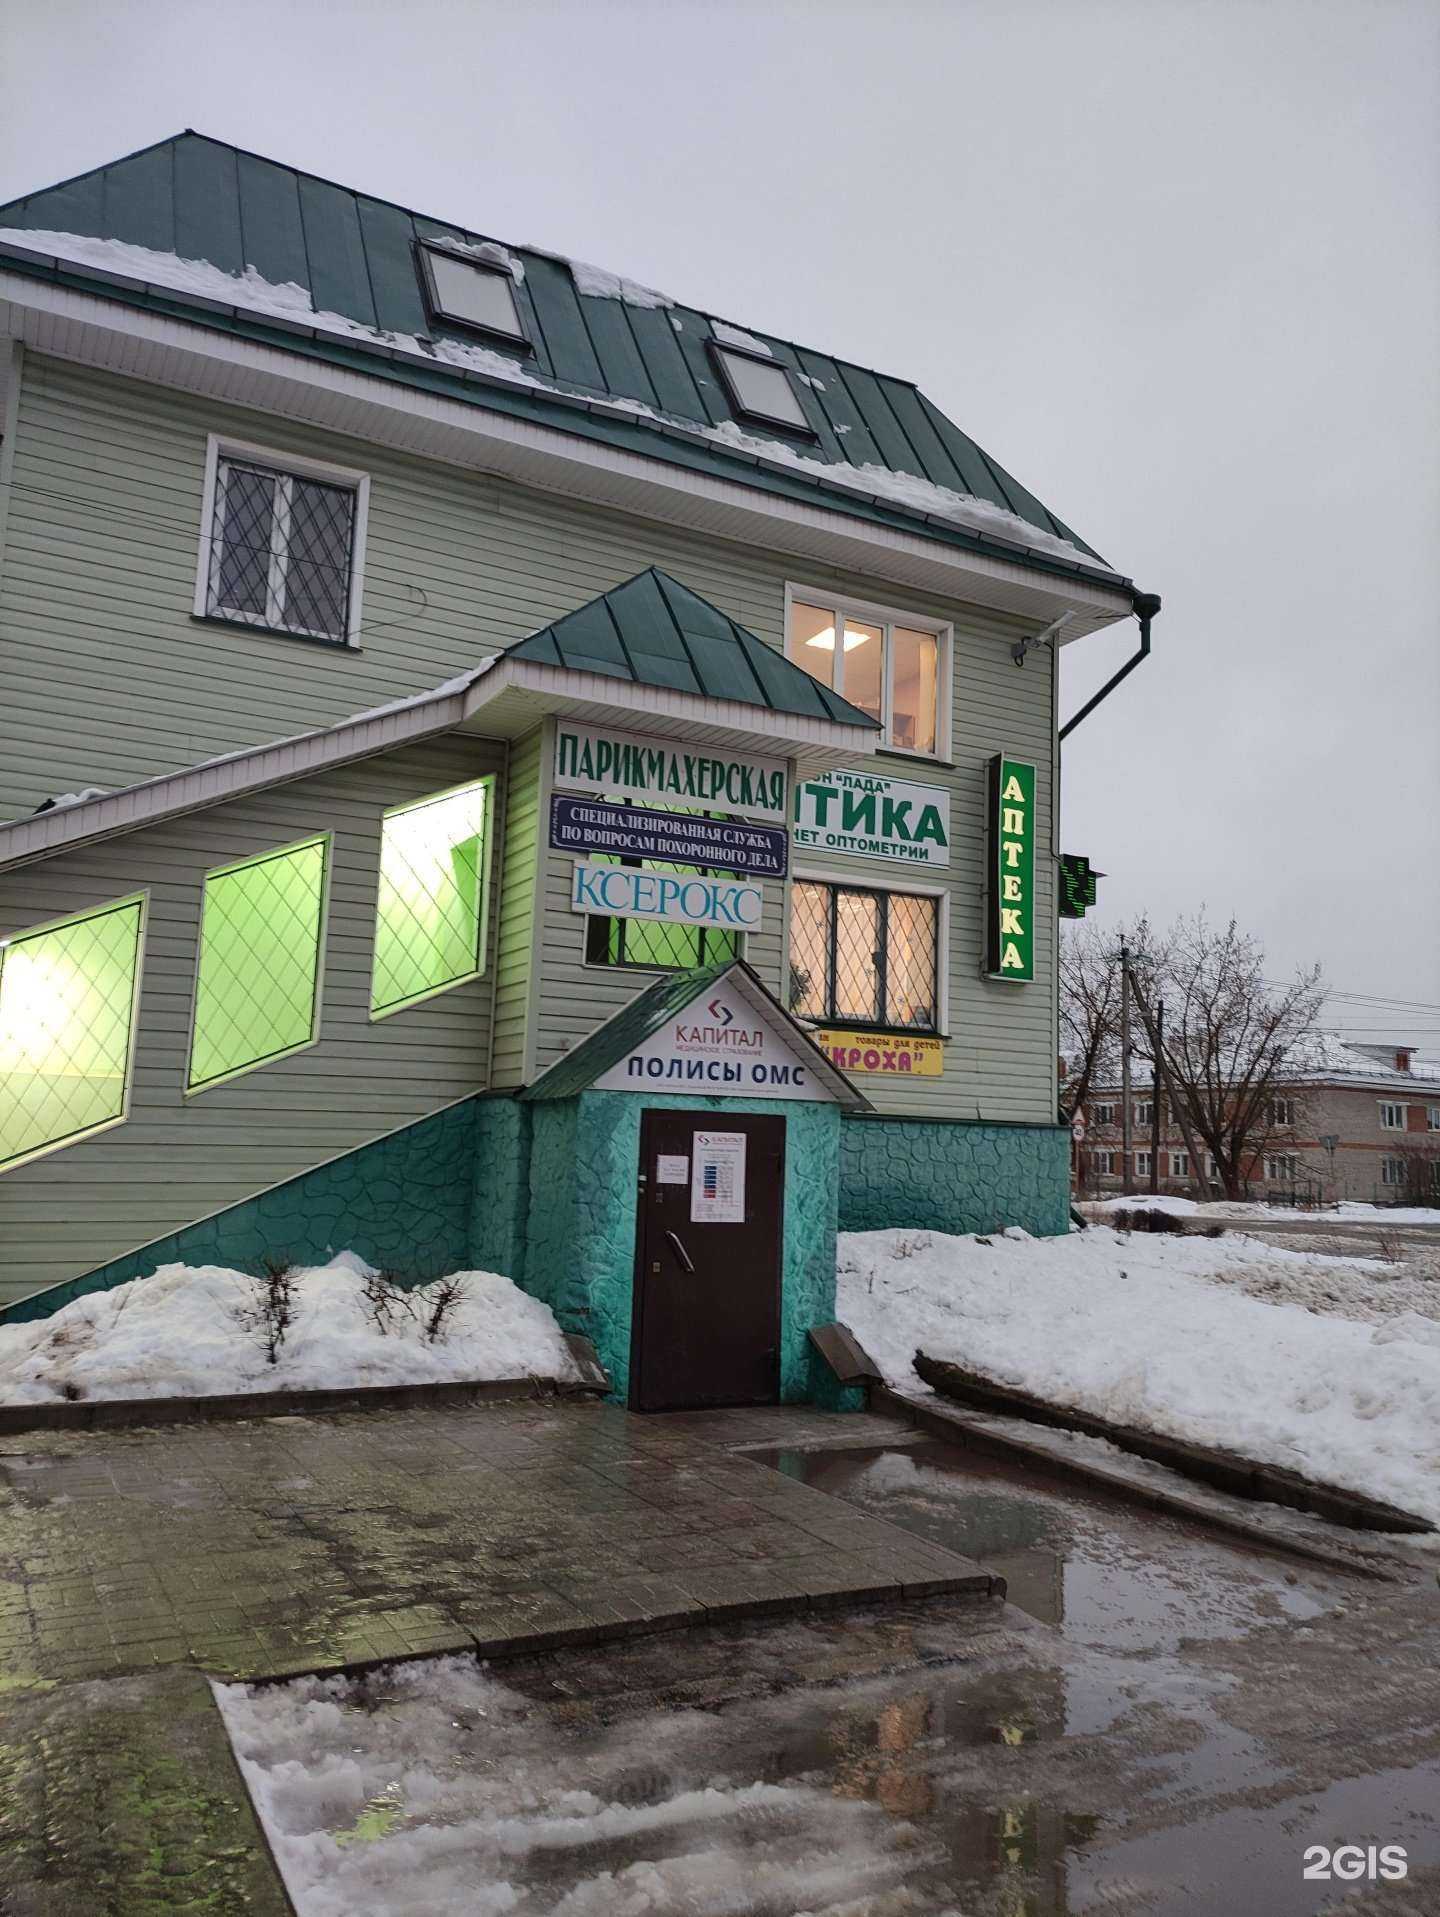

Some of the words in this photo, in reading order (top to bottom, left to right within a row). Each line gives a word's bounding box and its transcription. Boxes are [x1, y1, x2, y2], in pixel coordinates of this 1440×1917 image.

[559, 733, 784, 811] ПАРИКМАХЕРСКАЯ
[570, 806, 721, 841] СПЕЦИАЛИЗИРОВАННАЯ
[723, 830, 772, 849] СЛУЖБА
[795, 782, 948, 847] ТИКА
[561, 825, 581, 841] ПО
[584, 828, 655, 852] ВОПРОСАМ
[657, 838, 747, 865] ПОХОРОННОГО
[747, 852, 778, 870] ДЕЛА
[826, 833, 929, 860] ОПТОМЕТРИИ
[1001, 775, 1025, 969] АПТЕКА
[575, 867, 761, 924] КСЕРОКС
[676, 1025, 763, 1047] КАПИТАЛ
[628, 1056, 741, 1082] ПОЛИСЫ
[752, 1064, 805, 1086] ОМС
